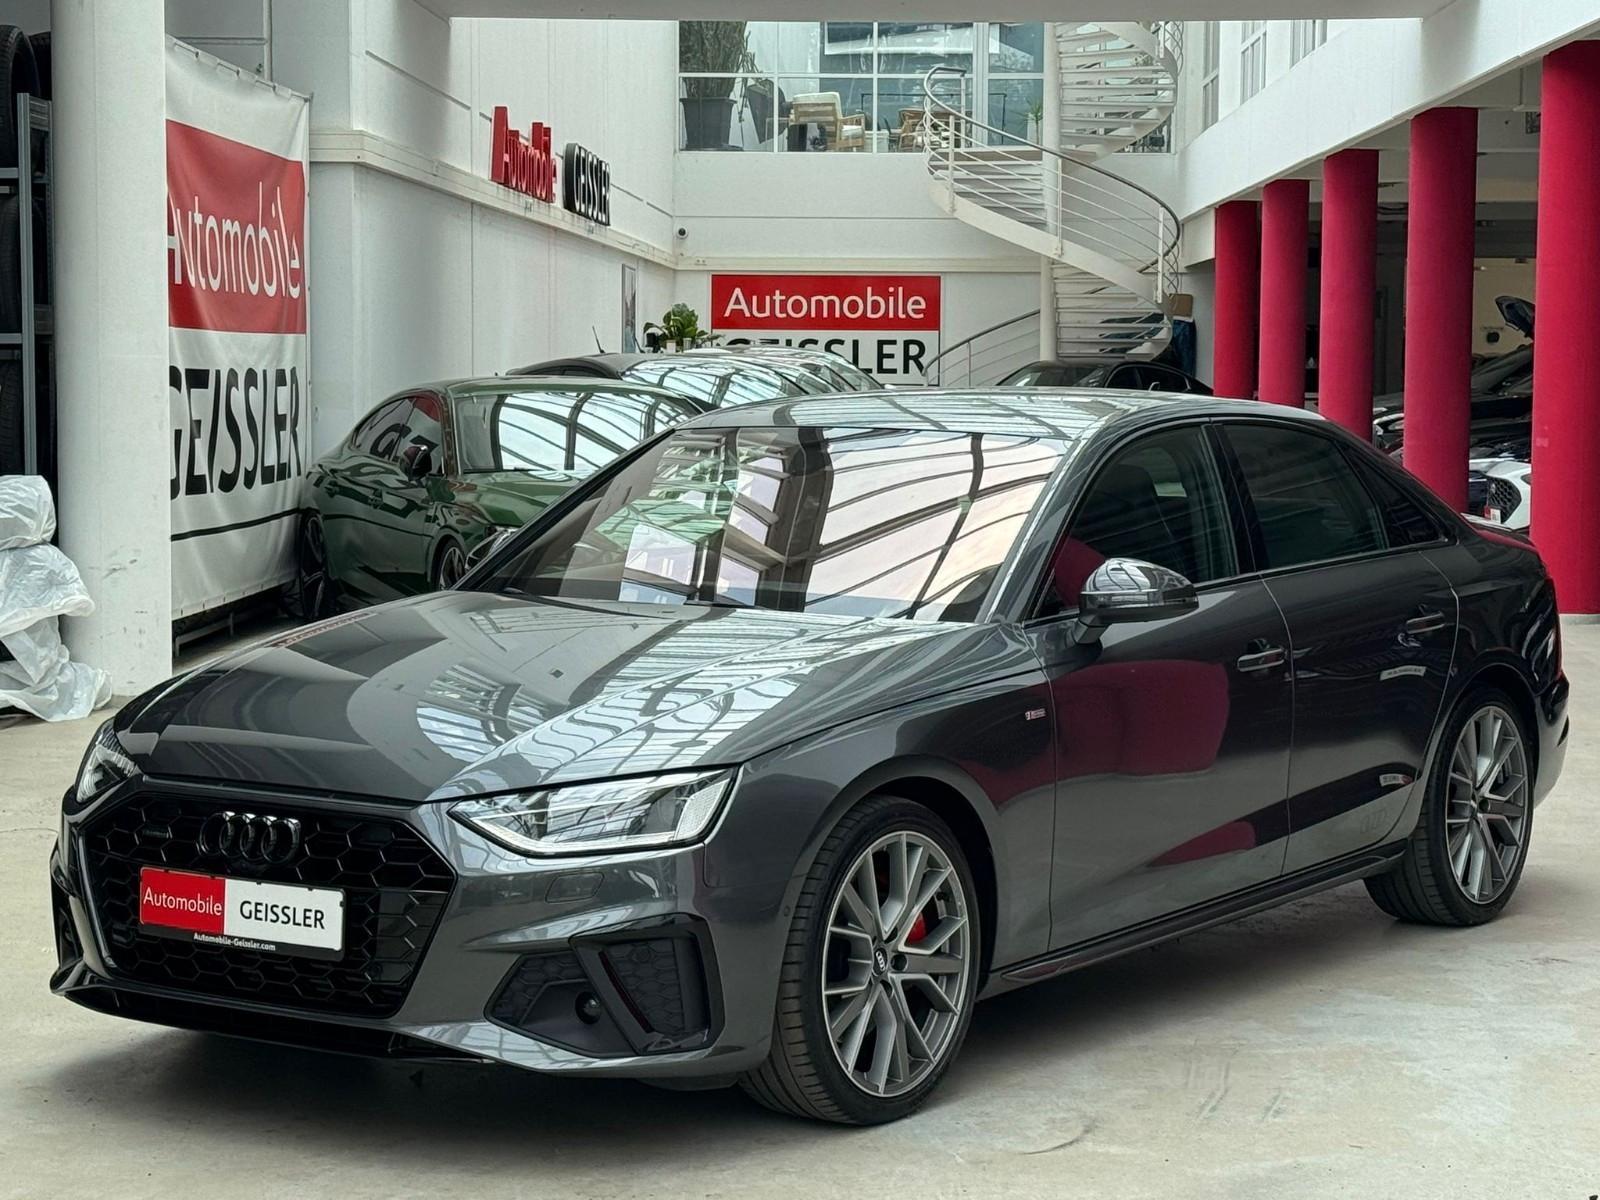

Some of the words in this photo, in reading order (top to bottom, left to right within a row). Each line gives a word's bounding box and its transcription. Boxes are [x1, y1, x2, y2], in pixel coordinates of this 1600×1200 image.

[723, 286, 927, 319] Automobile
[143, 886, 223, 916] Automobile
[239, 900, 325, 930] GEISSLER
[193, 932, 276, 951] Automobile-Geissler.com
